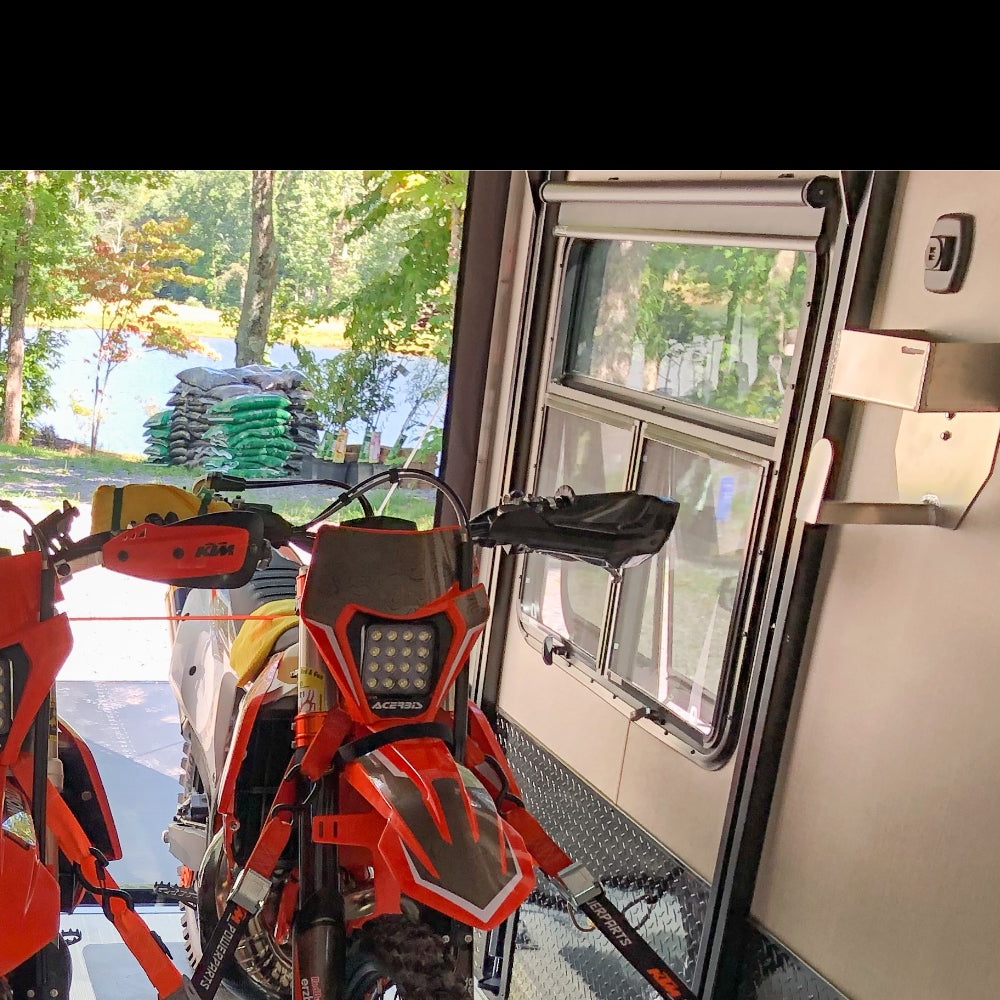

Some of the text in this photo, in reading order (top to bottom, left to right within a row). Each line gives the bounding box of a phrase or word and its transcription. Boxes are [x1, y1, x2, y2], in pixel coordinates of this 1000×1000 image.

[195, 542, 235, 558] KTM
[371, 701, 424, 710] ACERBIS
[200, 922, 236, 990] POWERPARTS
[647, 967, 682, 998] KTM
